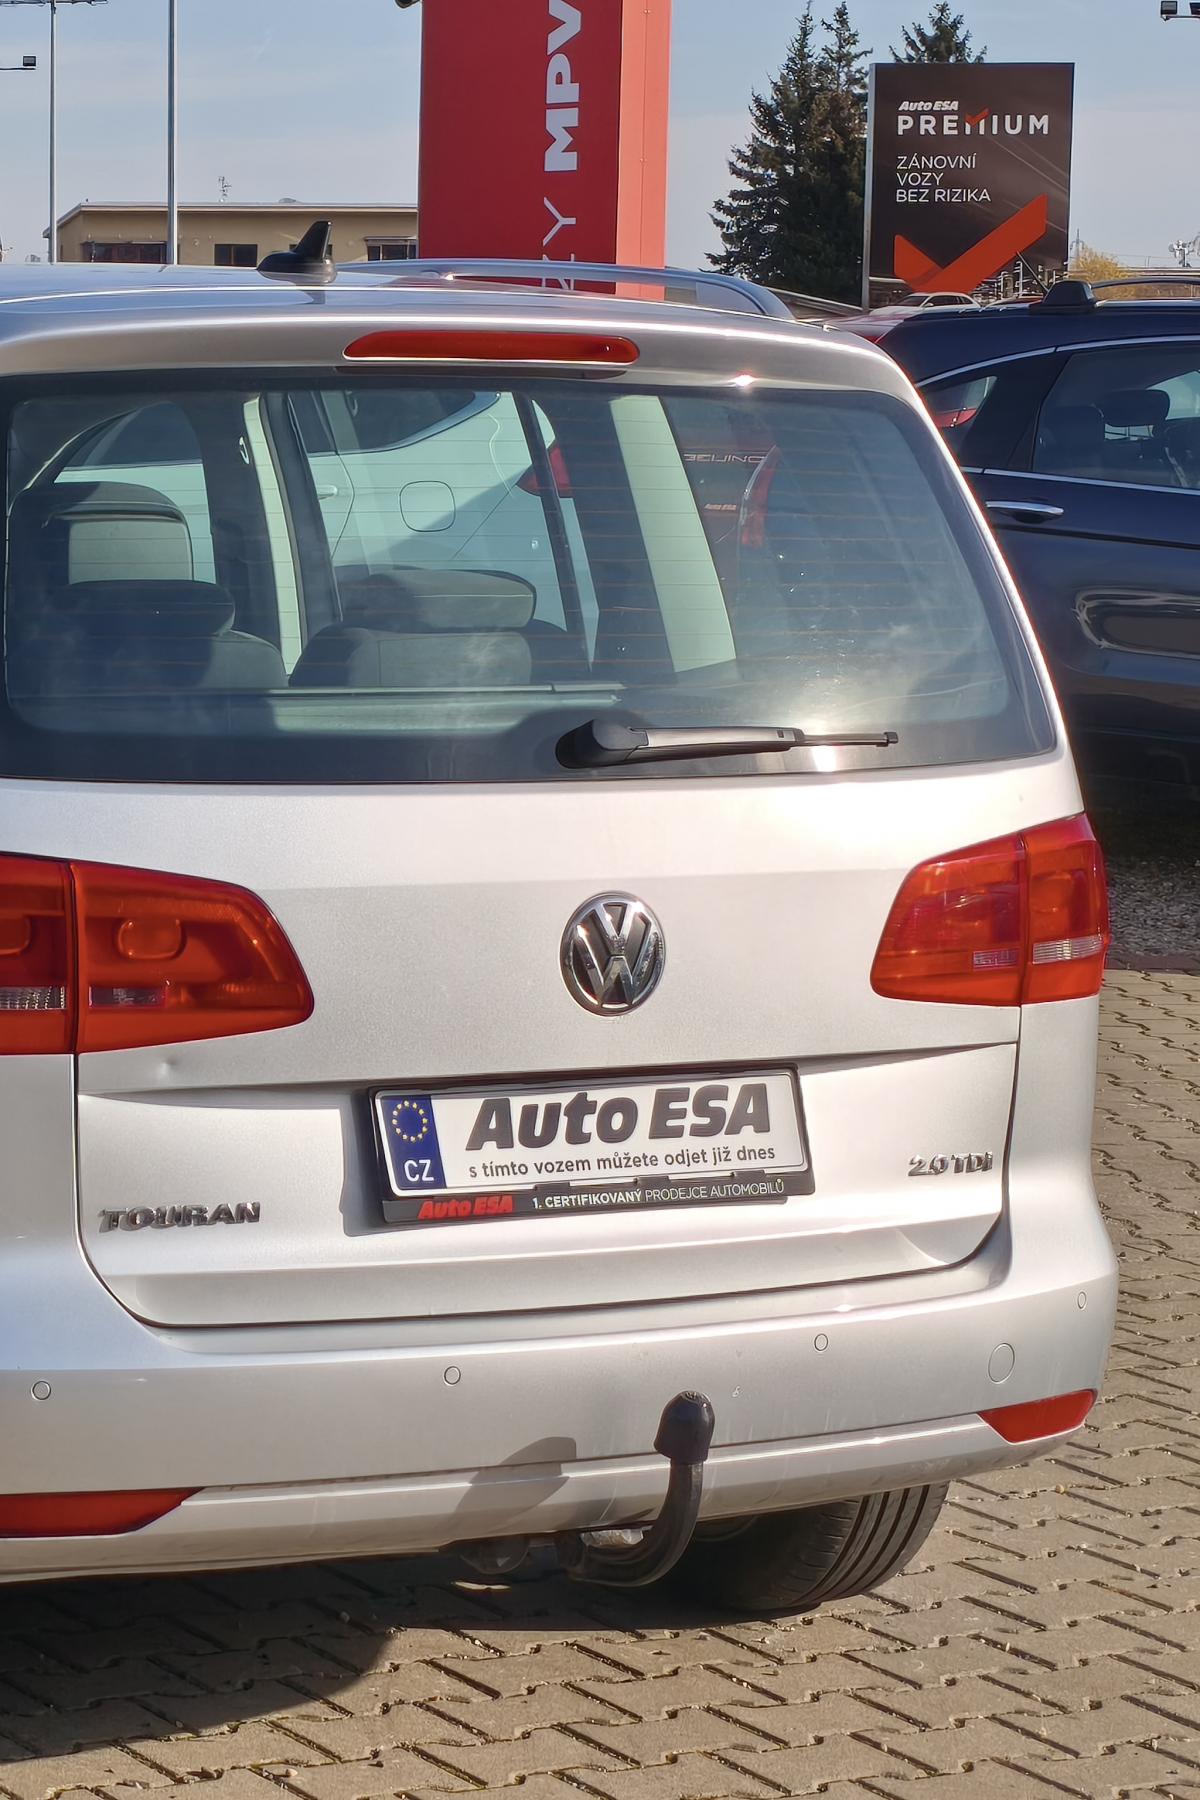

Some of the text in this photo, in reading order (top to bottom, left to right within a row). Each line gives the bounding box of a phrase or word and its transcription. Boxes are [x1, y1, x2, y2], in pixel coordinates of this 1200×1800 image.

[544, 0, 582, 172] MPV
[899, 101, 959, 111] Auto ESA
[897, 112, 1049, 135] PREMIUM
[896, 153, 977, 170] ZÁNOVNÍ
[896, 172, 944, 186] VOZY
[896, 188, 992, 203] BEZ RIZIKA
[465, 1083, 771, 1151] Auto ESA
[404, 1159, 435, 1182] CZ
[469, 1146, 775, 1178] s tímto vozem můžete odjet již dnes
[545, 1189, 642, 1208] CERTIFIKOVANÝ
[645, 1186, 708, 1201] PRODEJCE
[710, 1178, 785, 1197] AUTOMOBILŮ
[99, 1201, 261, 1233] TOURAN
[417, 1195, 514, 1220] Auto ESA
